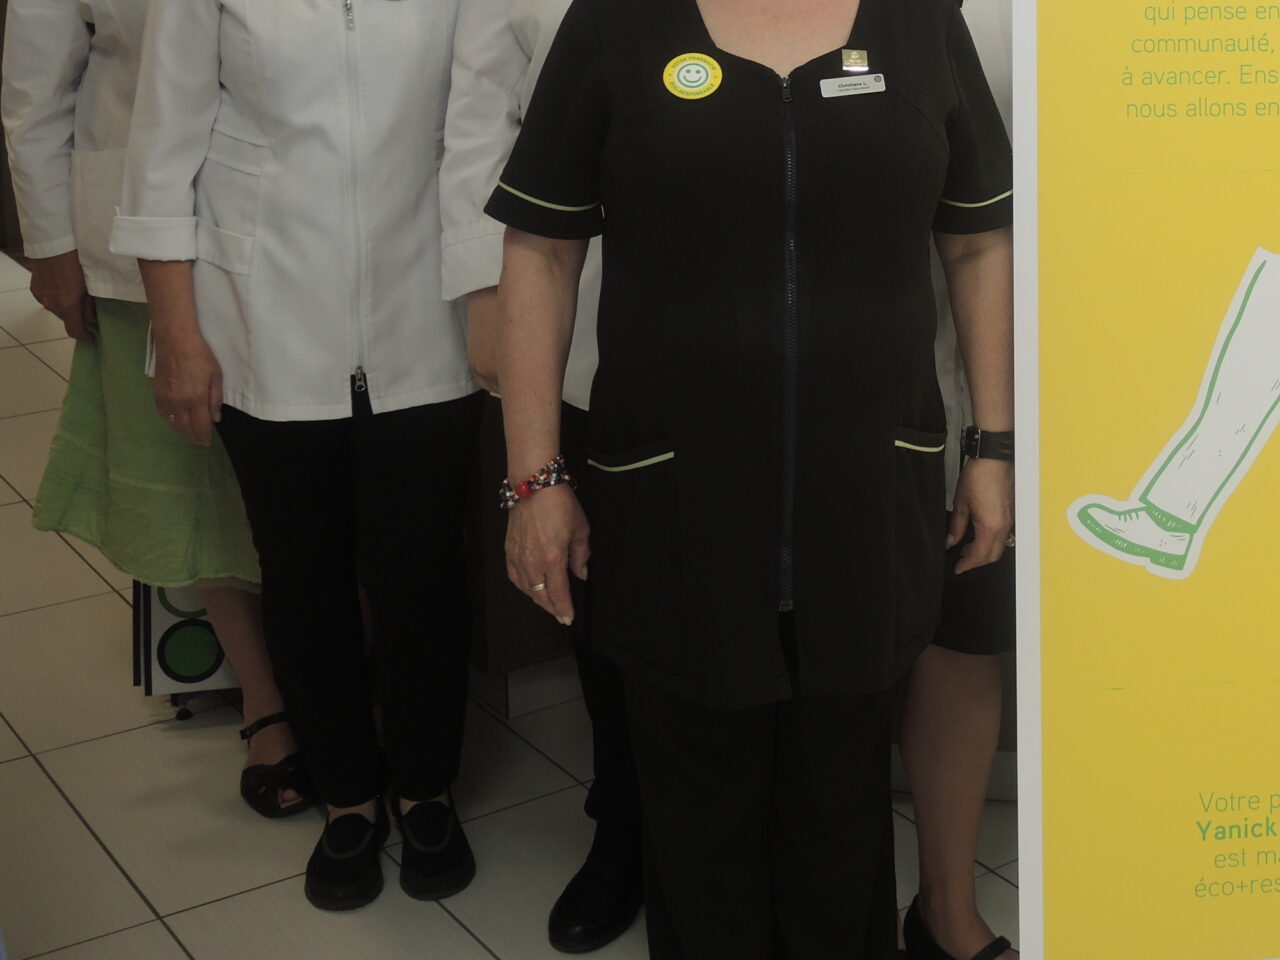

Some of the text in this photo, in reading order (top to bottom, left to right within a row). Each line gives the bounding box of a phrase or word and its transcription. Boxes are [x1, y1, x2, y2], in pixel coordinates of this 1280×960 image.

[1145, 1, 1174, 25] qui
[1184, 6, 1247, 25] pense
[1132, 32, 1274, 53] communauté,
[1122, 66, 1133, 86] à
[1141, 71, 1230, 85] avancer.
[1127, 104, 1178, 118] nous
[1186, 98, 1247, 117] allons
[1255, 102, 1279, 116] en
[1199, 792, 1260, 813] Votre
[1195, 816, 1278, 841] Yanick
[1214, 847, 1246, 868] est
